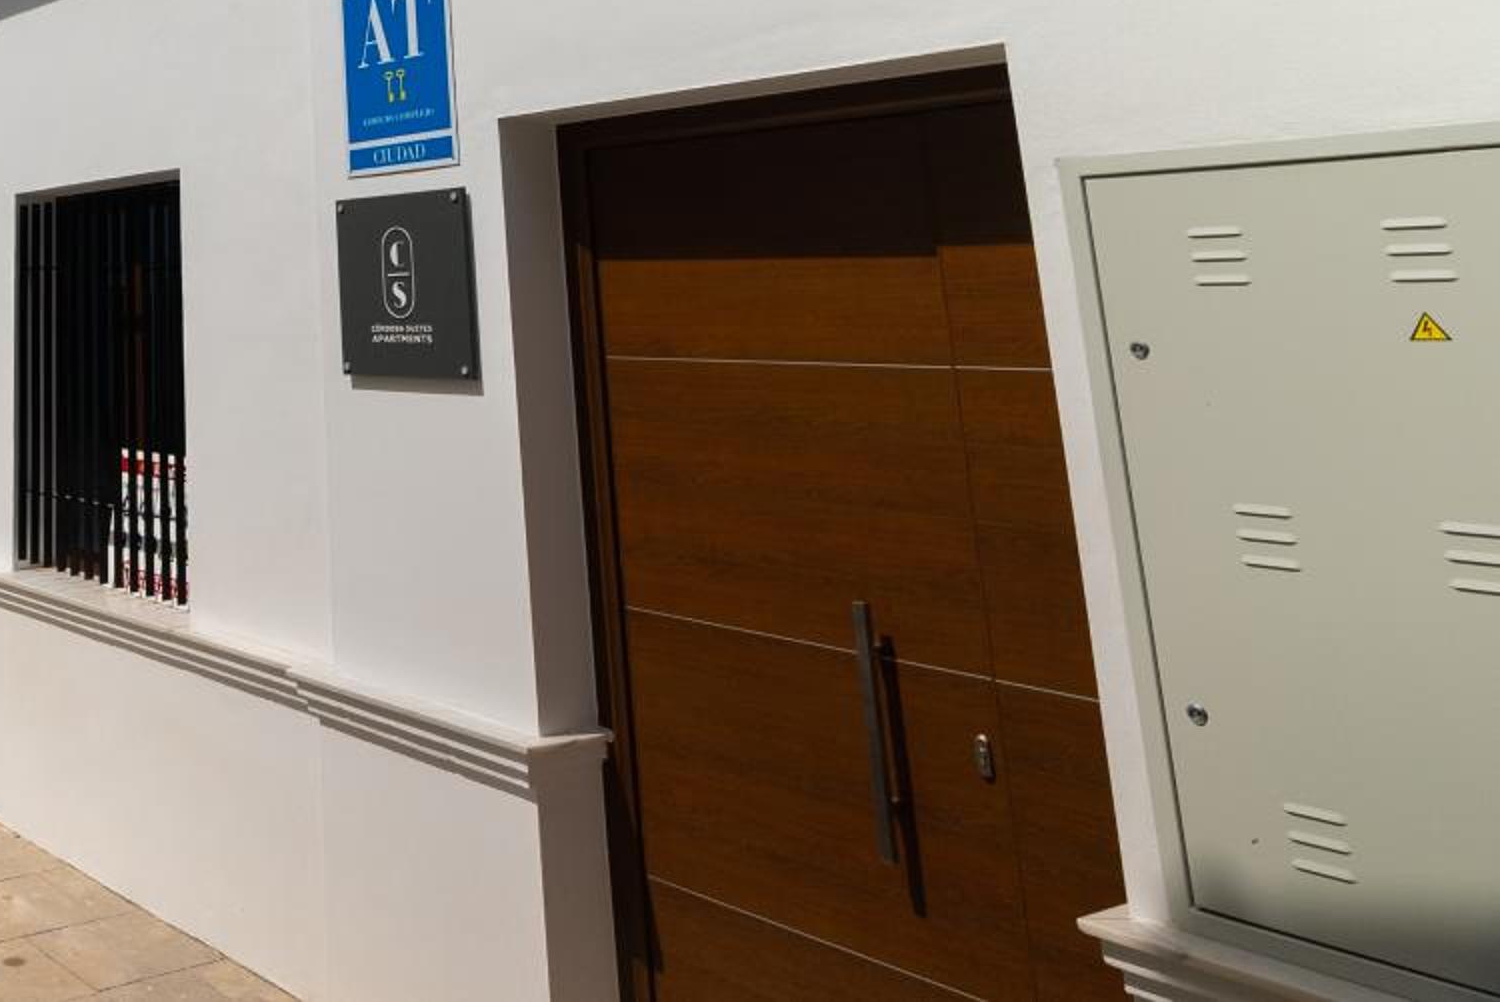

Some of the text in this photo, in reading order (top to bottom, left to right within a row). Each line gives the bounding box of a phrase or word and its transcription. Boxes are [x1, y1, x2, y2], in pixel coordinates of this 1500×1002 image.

[373, 143, 426, 165] CIUDAD
[389, 241, 404, 267] C
[391, 281, 407, 308] S
[371, 334, 433, 343] APARTMENTS
